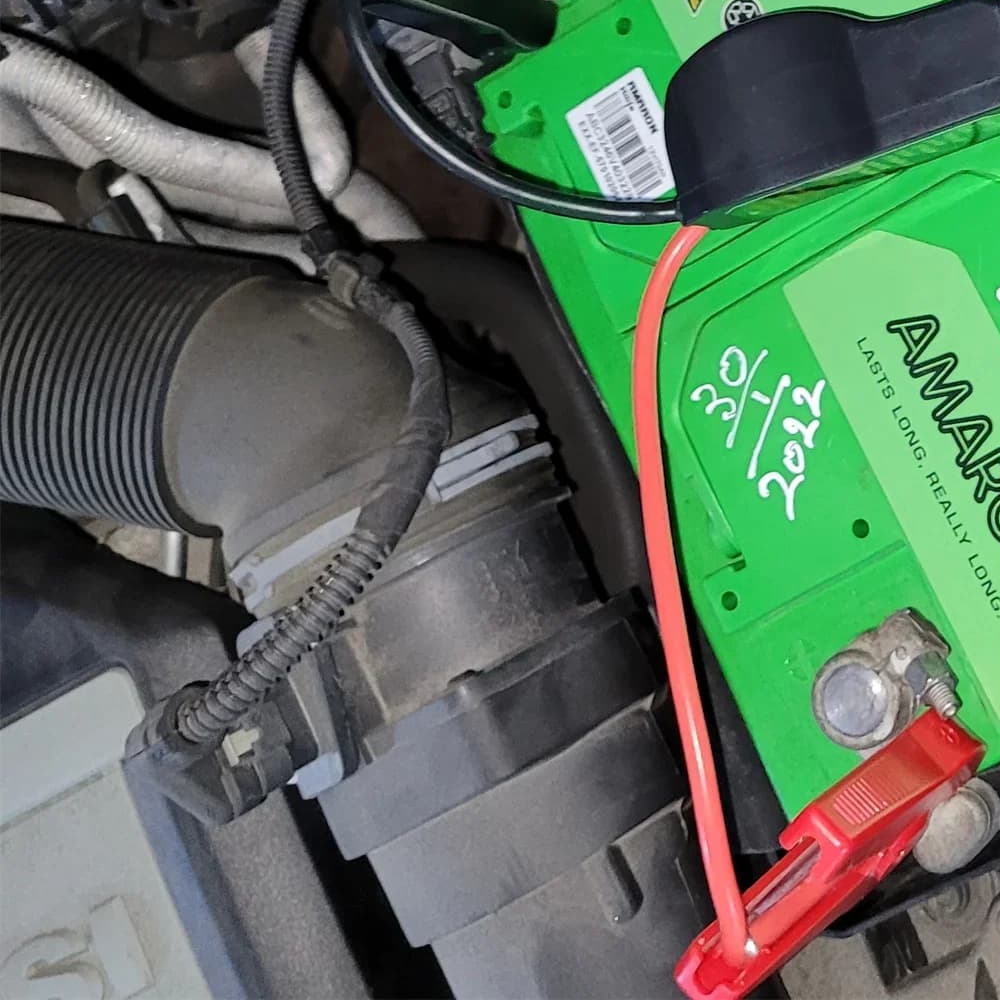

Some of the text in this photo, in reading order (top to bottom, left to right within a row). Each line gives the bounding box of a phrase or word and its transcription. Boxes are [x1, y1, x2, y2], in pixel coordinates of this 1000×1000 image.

[856, 335, 896, 400] LASTS
[891, 404, 927, 469] LONG,
[925, 471, 972, 545] REALLY
